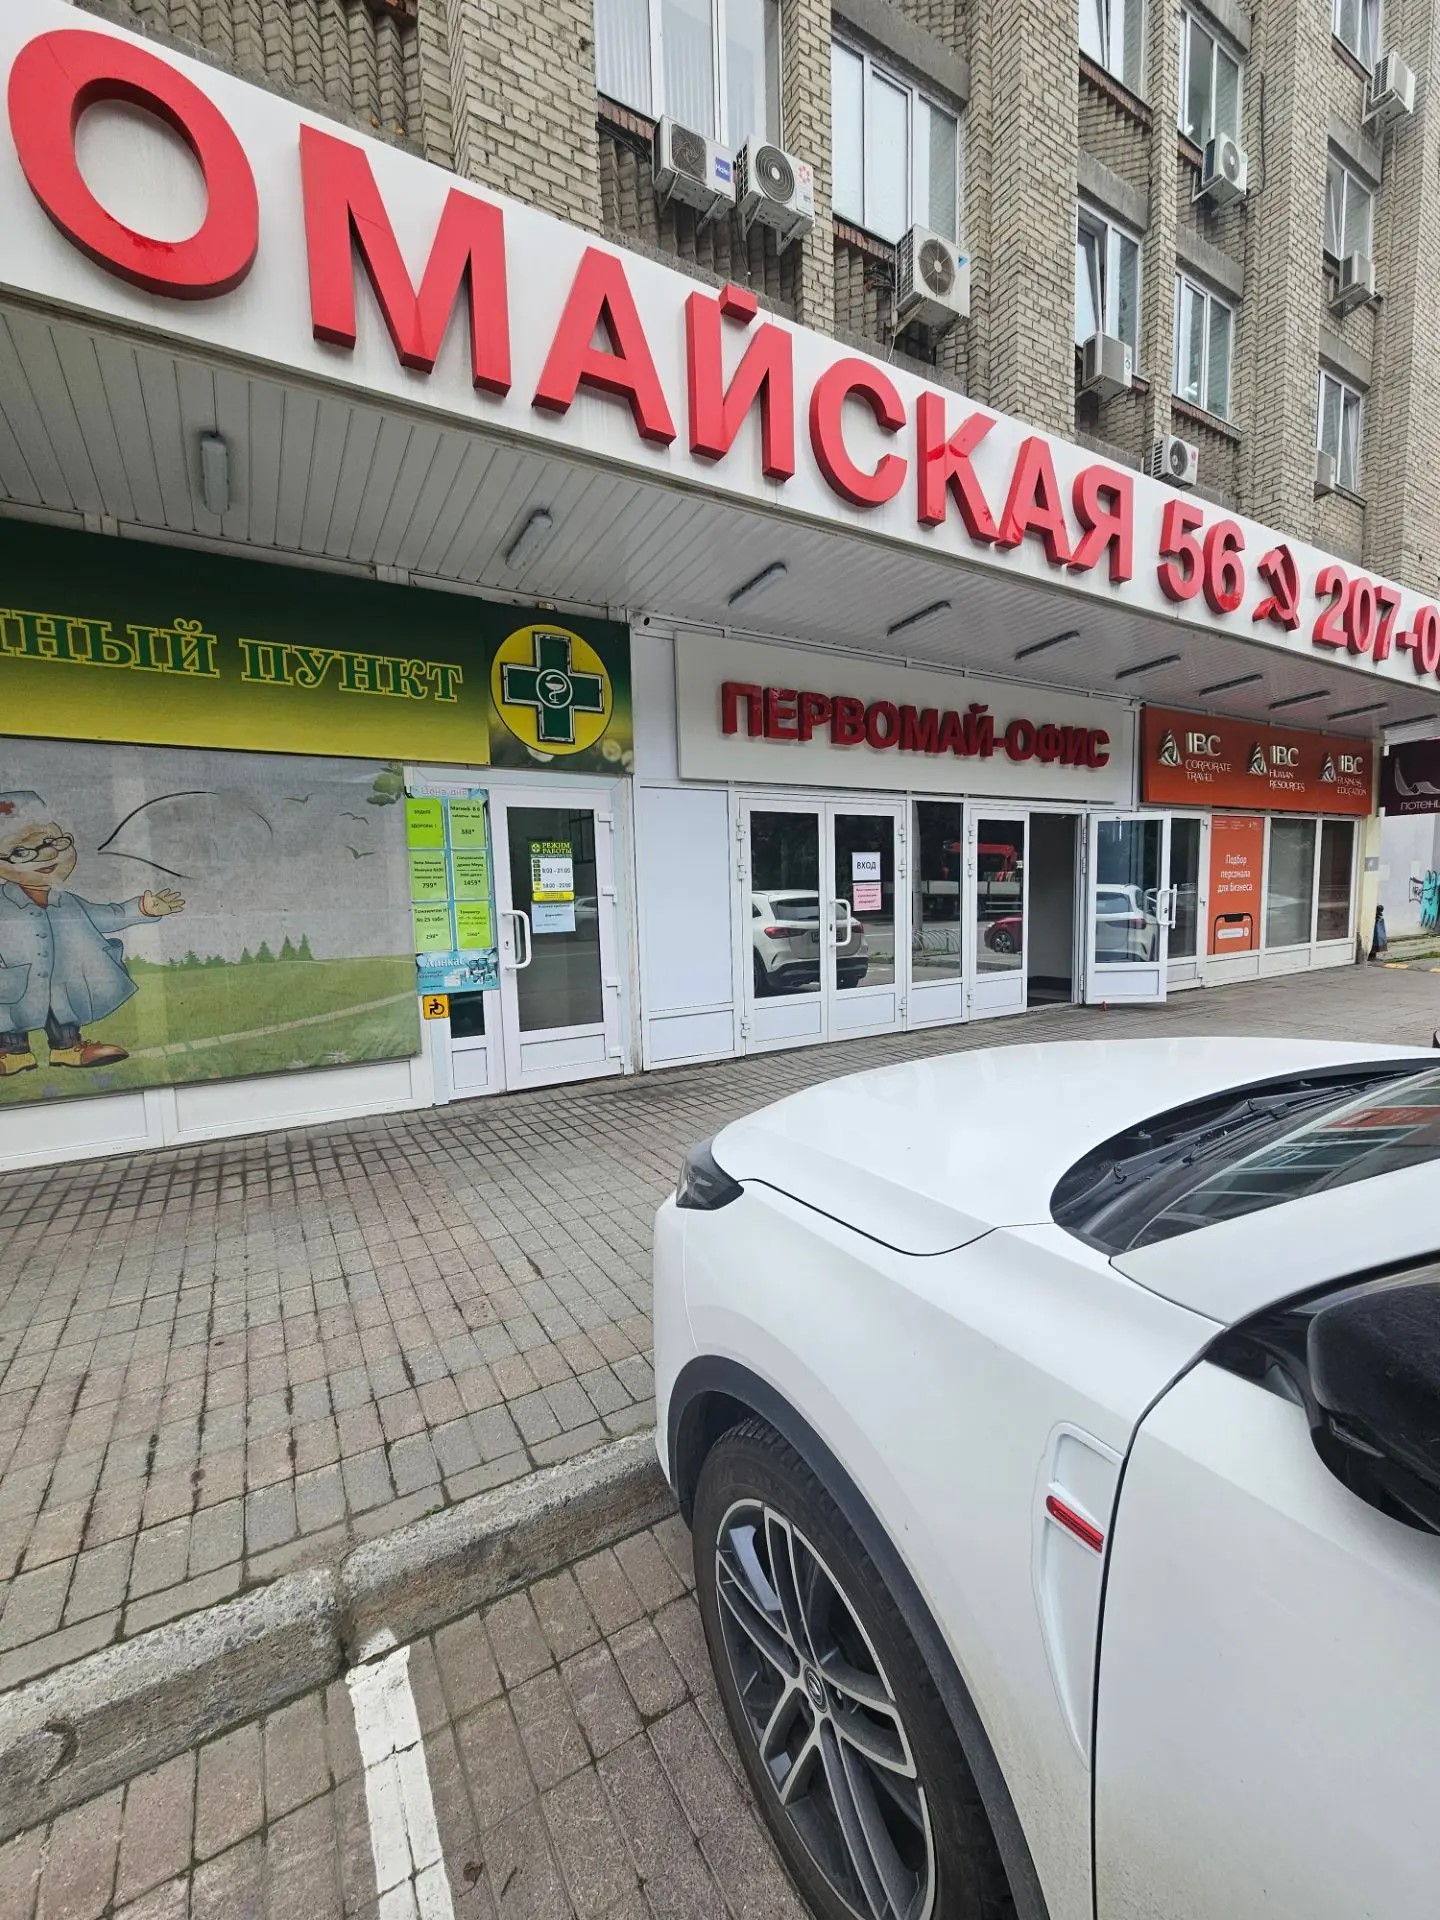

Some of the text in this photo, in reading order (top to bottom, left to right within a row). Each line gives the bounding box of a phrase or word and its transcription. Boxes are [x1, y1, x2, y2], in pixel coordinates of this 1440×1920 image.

[8, 29, 1440, 681] ОМАЙСКАЯ 56 207-0
[239, 638, 463, 702] ПУНКТ
[721, 681, 1111, 768] ПЕРВОМАЙ-ОФИС
[1186, 732, 1222, 757] IBC
[1270, 745, 1300, 767] IBC
[1338, 755, 1364, 775] IBC
[856, 861, 877, 870] ВХОД
[1225, 854, 1248, 866] Подбор
[1220, 869, 1251, 880] персонала
[1217, 882, 1253, 893] для бизнеса
